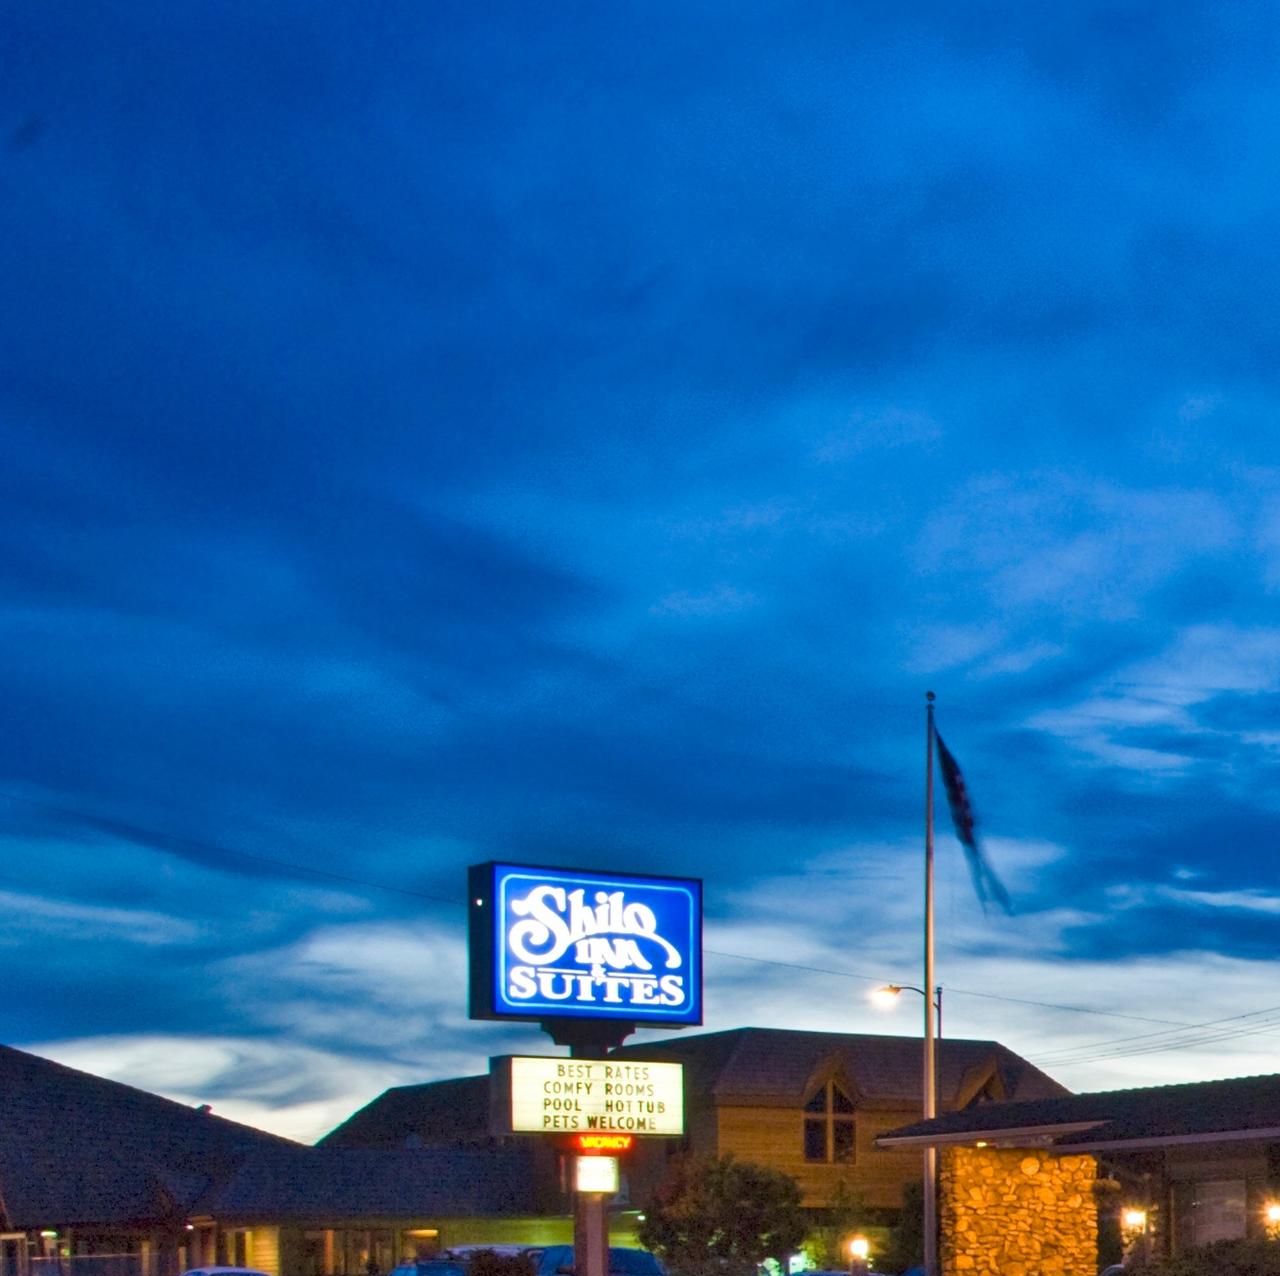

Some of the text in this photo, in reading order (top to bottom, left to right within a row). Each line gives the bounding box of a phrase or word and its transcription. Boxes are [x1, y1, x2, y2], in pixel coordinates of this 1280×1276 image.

[509, 885, 682, 969] Shilo
[509, 966, 685, 1006] SUITES
[557, 1064, 651, 1081] BEST RATES
[543, 1081, 655, 1097] COMFY ROOMS
[543, 1098, 666, 1113] POOL HOT TUB
[543, 1115, 657, 1130] PETS WELCOME
